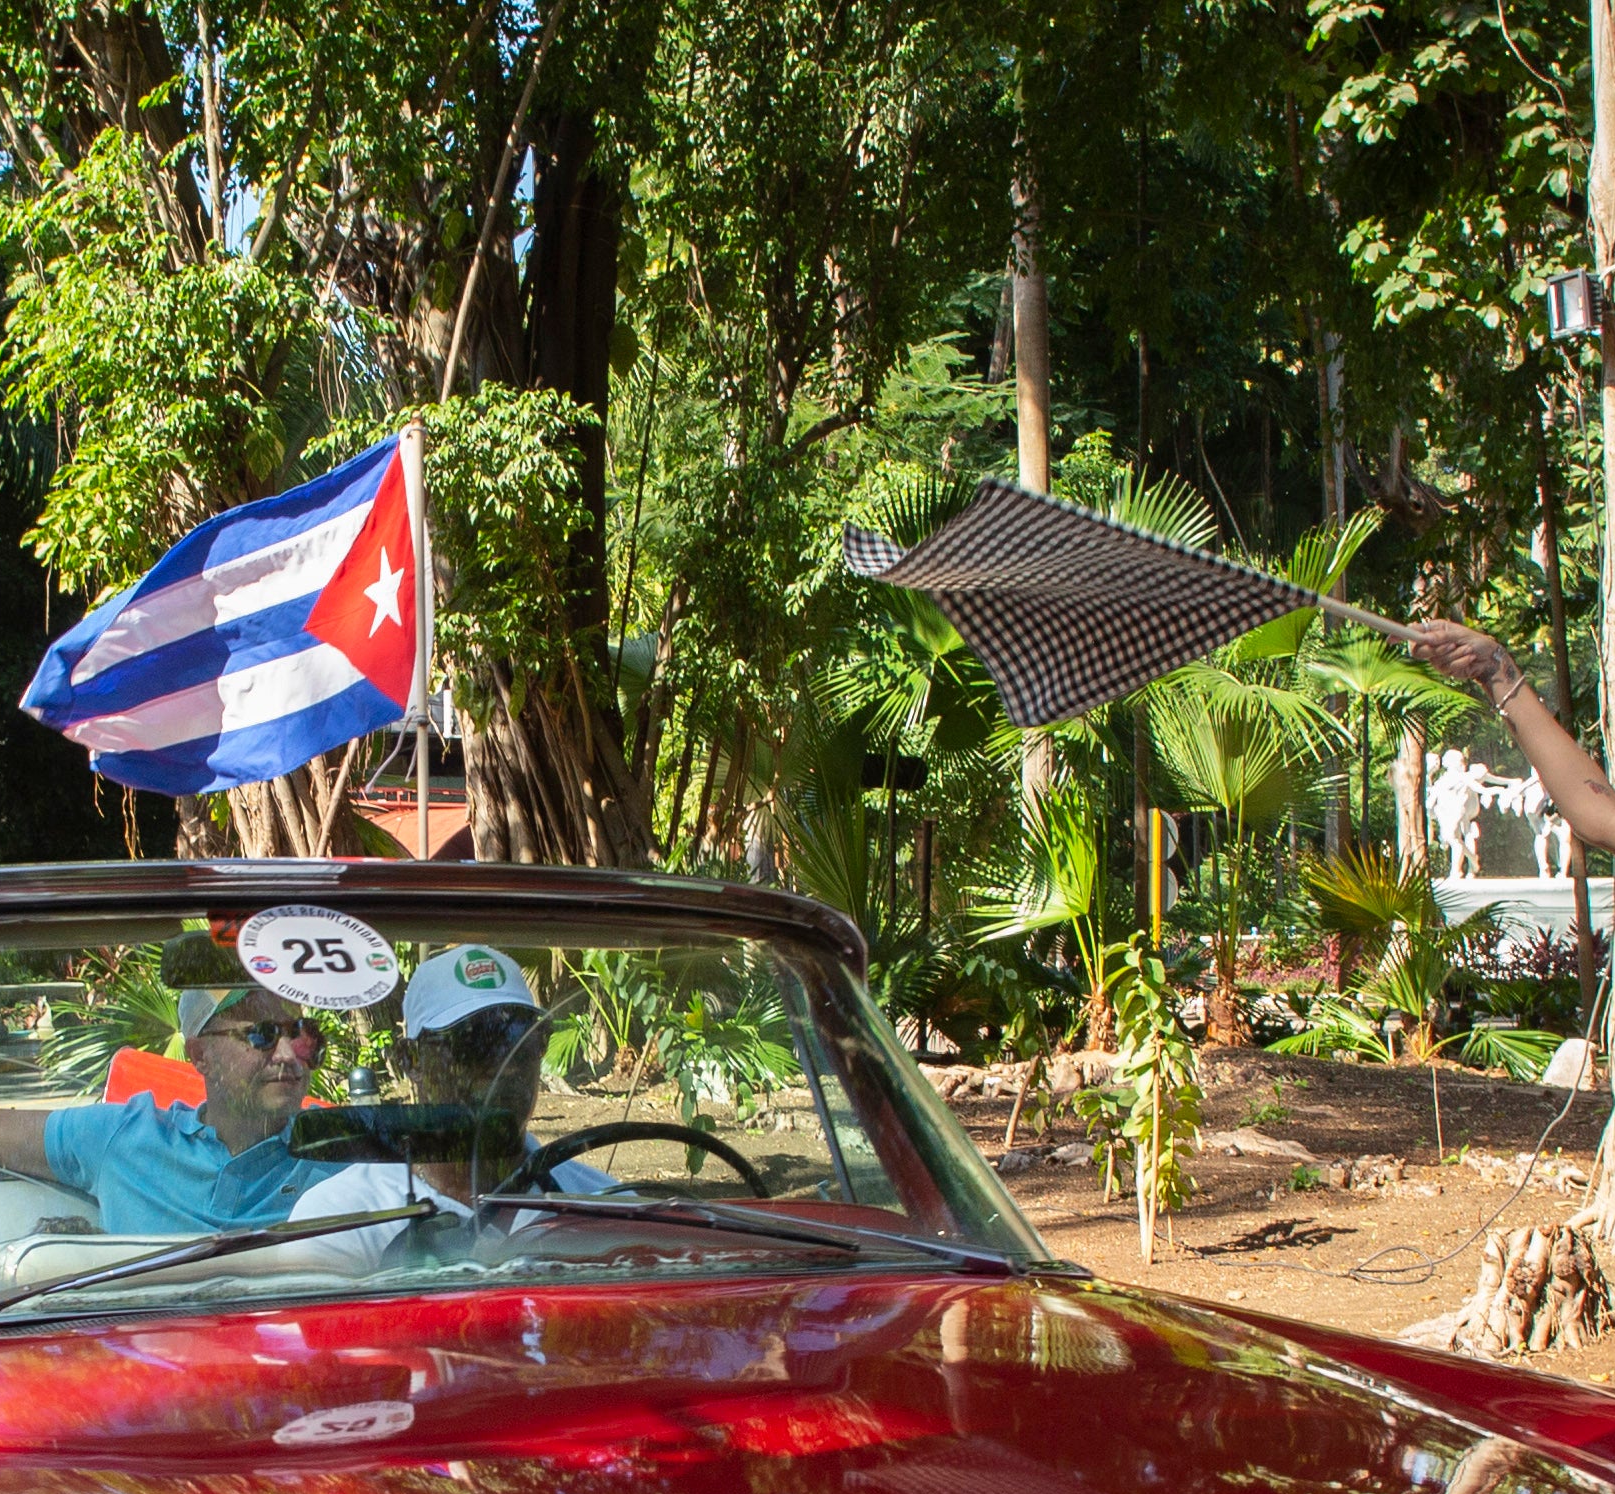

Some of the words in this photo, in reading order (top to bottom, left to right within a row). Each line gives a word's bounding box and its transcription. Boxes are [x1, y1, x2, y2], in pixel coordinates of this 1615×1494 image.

[278, 906, 296, 917] DE
[299, 906, 384, 949] REGULARIDAD
[282, 938, 356, 974] 25
[278, 983, 310, 1002] COPA
[313, 994, 368, 1007] CASTROL
